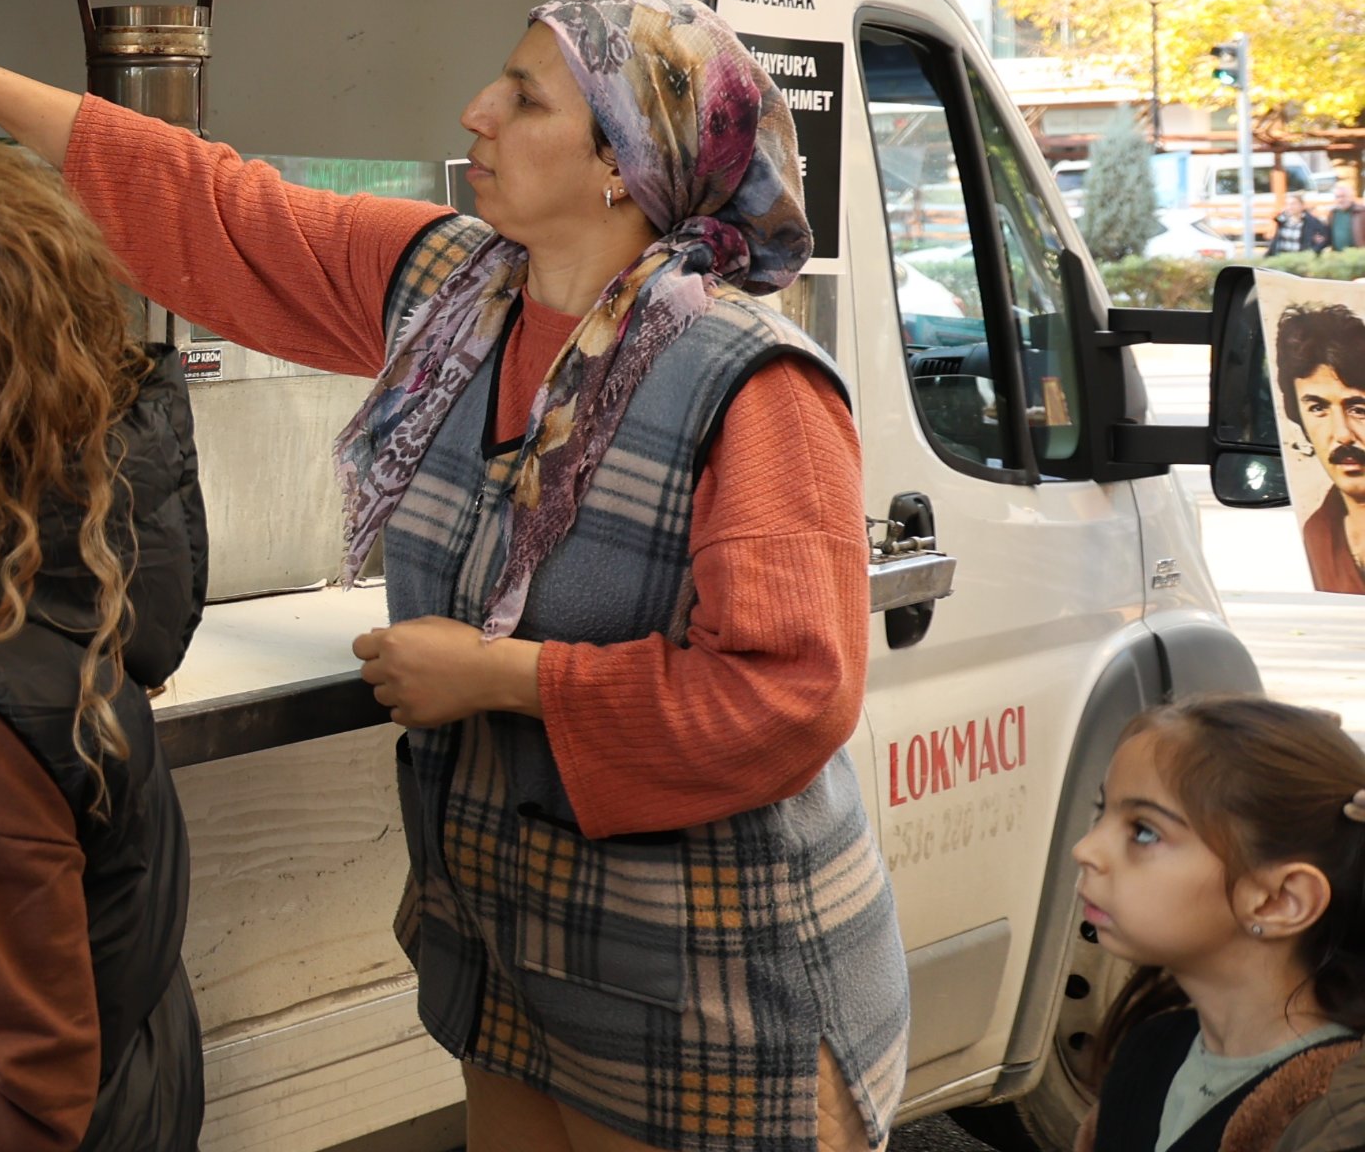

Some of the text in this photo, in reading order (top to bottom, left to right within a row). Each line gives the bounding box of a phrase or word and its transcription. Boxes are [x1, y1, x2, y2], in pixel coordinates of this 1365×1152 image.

[756, 51, 817, 78] TAYFUR'A
[187, 352, 200, 363] ALP
[889, 705, 1027, 808] LOKMACI
